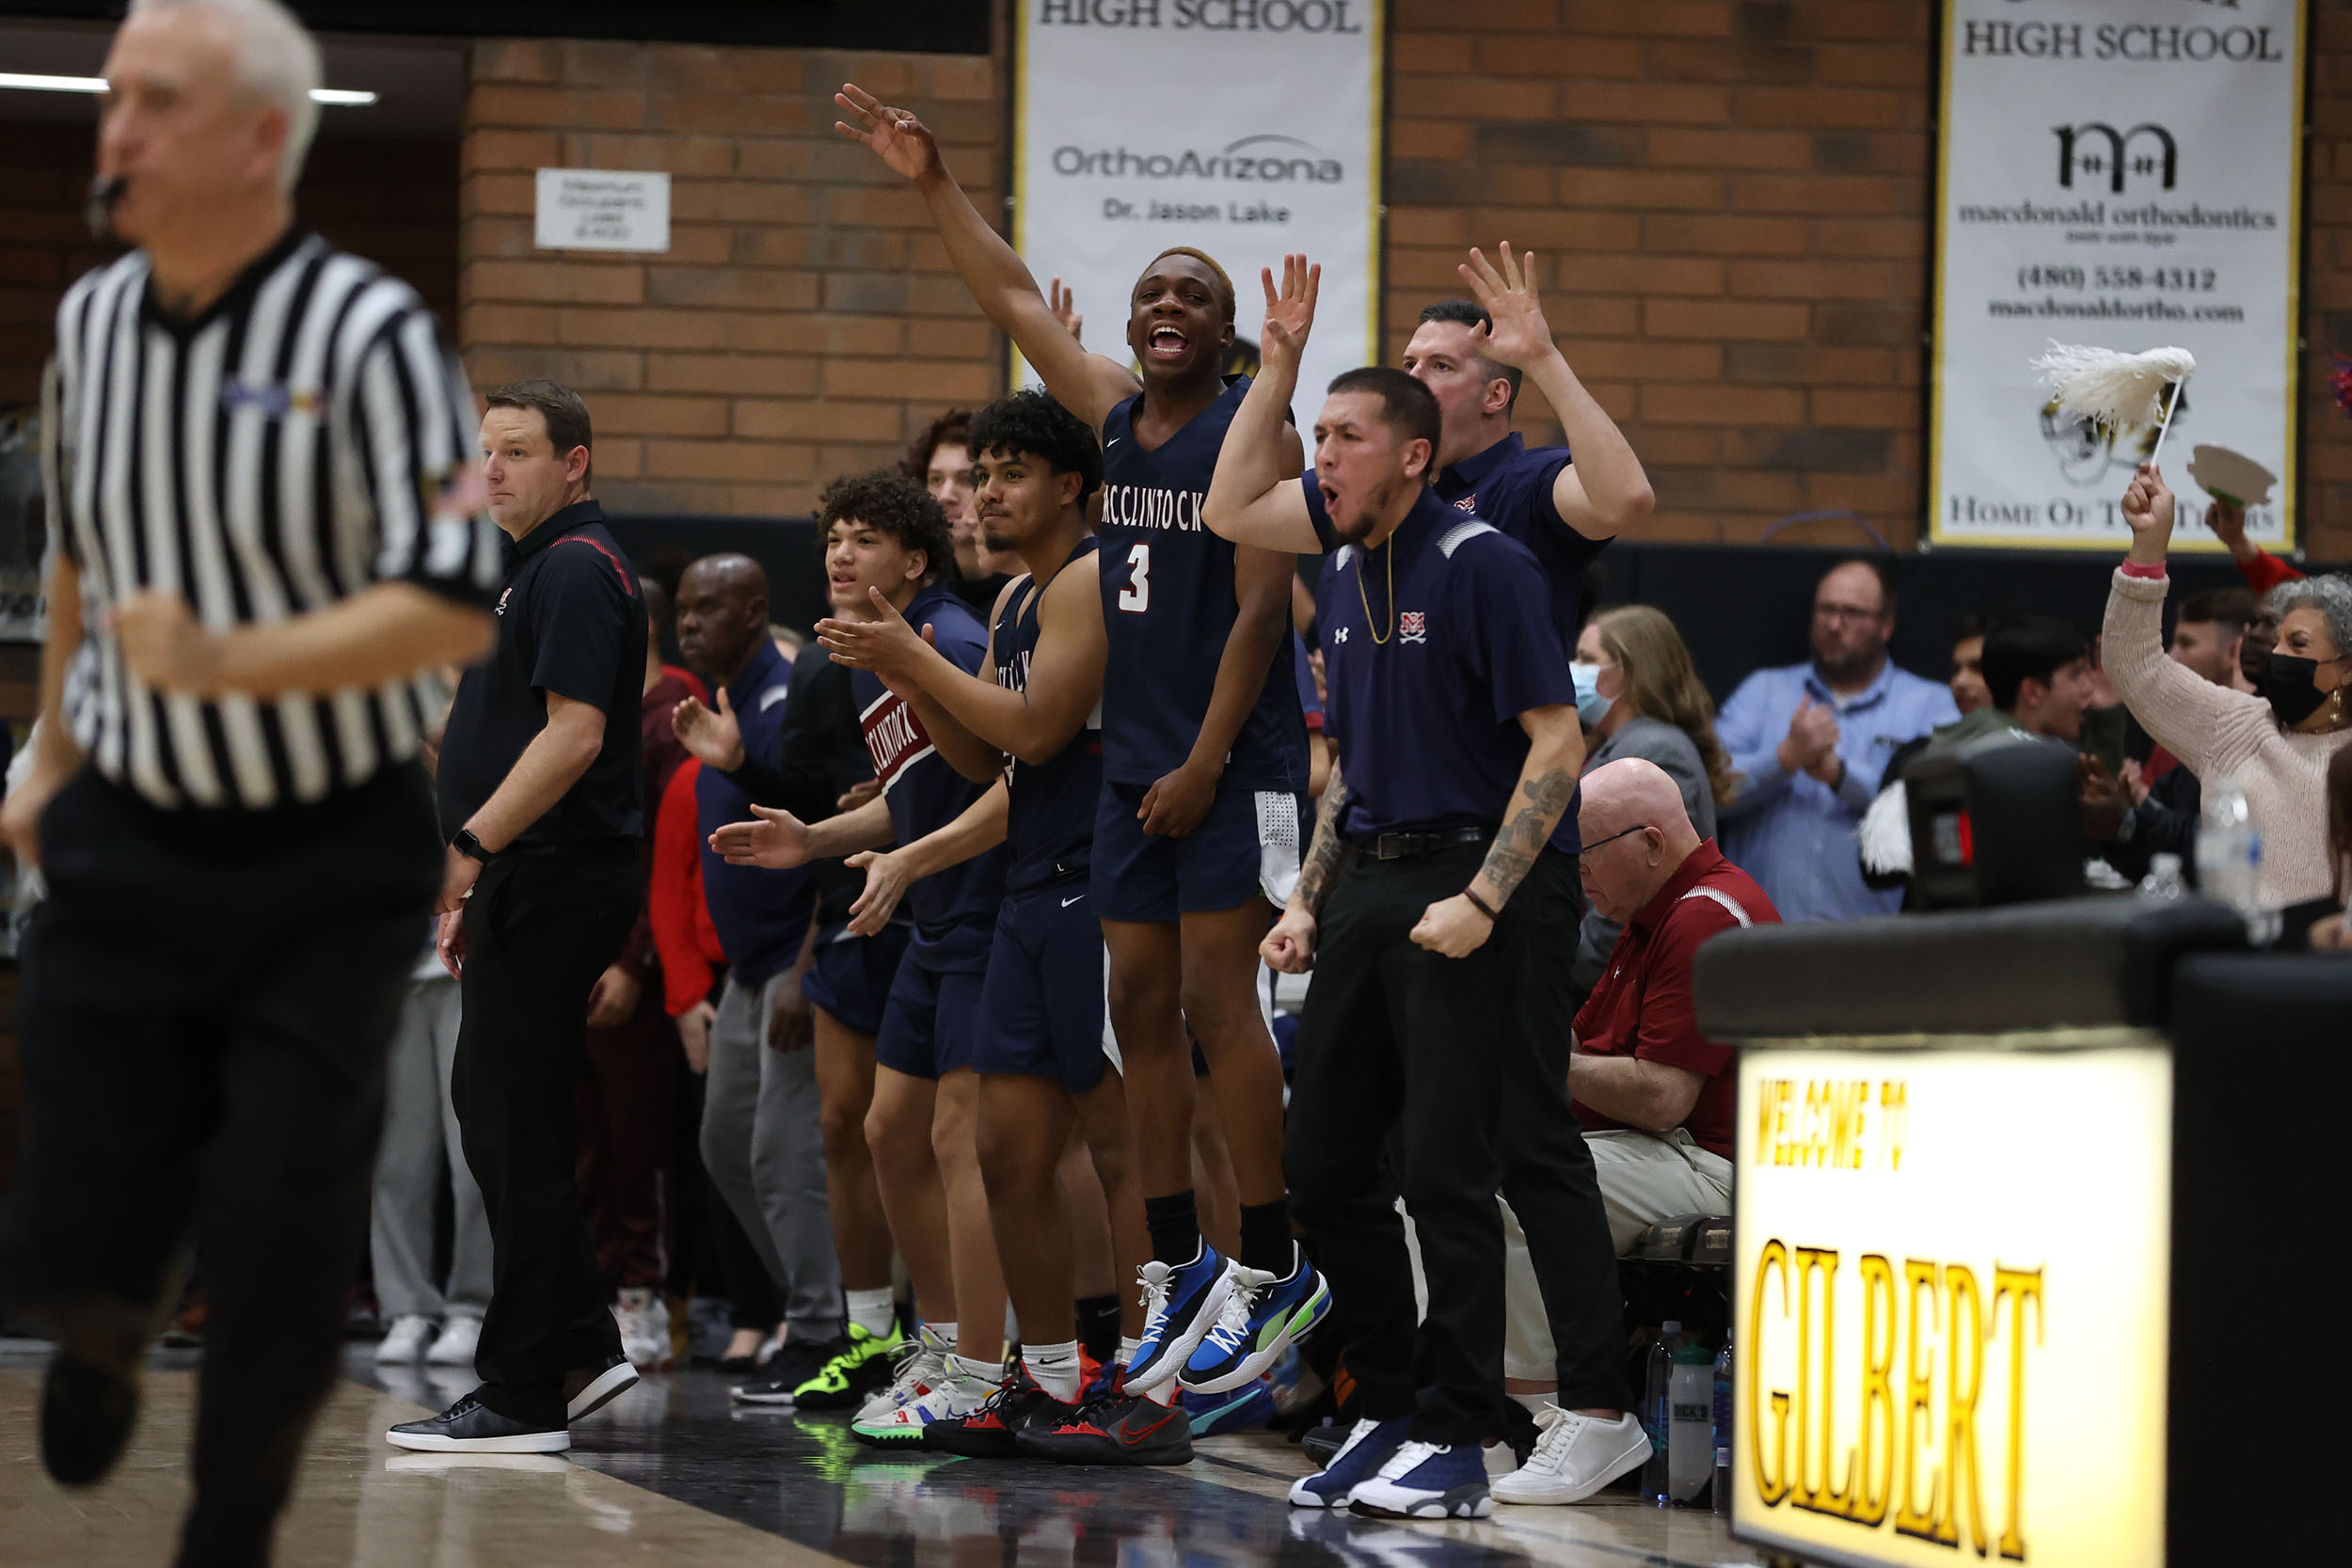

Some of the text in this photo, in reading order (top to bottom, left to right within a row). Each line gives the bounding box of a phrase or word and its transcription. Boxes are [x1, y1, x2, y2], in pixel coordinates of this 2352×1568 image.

[1040, 0, 1362, 35] HIGH SCHOOL
[1964, 20, 2283, 63] HIGH SCHOOL
[1052, 146, 1344, 183] OrthoArizona
[1103, 198, 1292, 224] Dr. Jason Lake
[1959, 198, 2278, 230] macdonald orthodontics
[1988, 294, 2245, 323] macdonaldortho.com
[1118, 542, 1152, 614] 3
[1756, 1079, 1870, 1169] WELCOME
[1750, 1239, 2045, 1561] GILBERT
